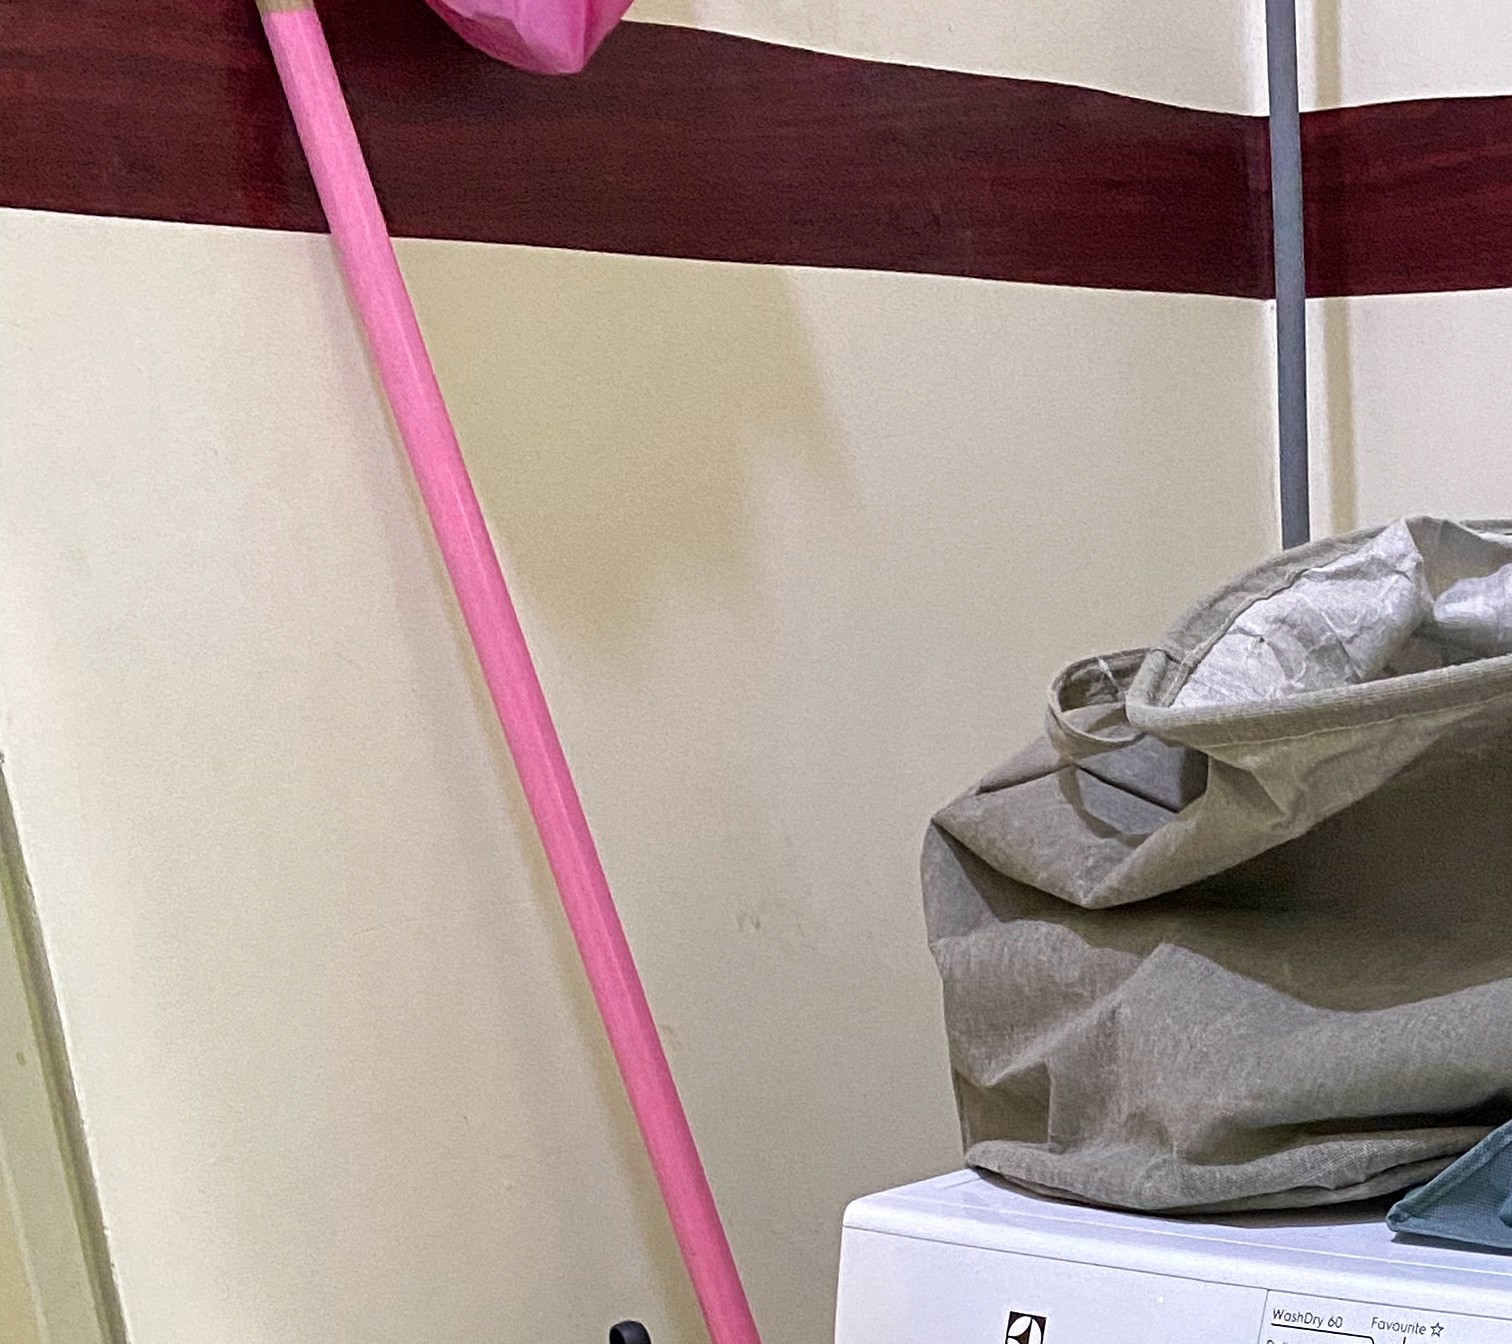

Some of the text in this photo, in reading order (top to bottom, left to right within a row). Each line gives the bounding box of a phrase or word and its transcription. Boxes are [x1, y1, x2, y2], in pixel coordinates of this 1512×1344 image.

[1272, 1308, 1343, 1329] WashDry 60
[1371, 1316, 1428, 1335] Favourite
